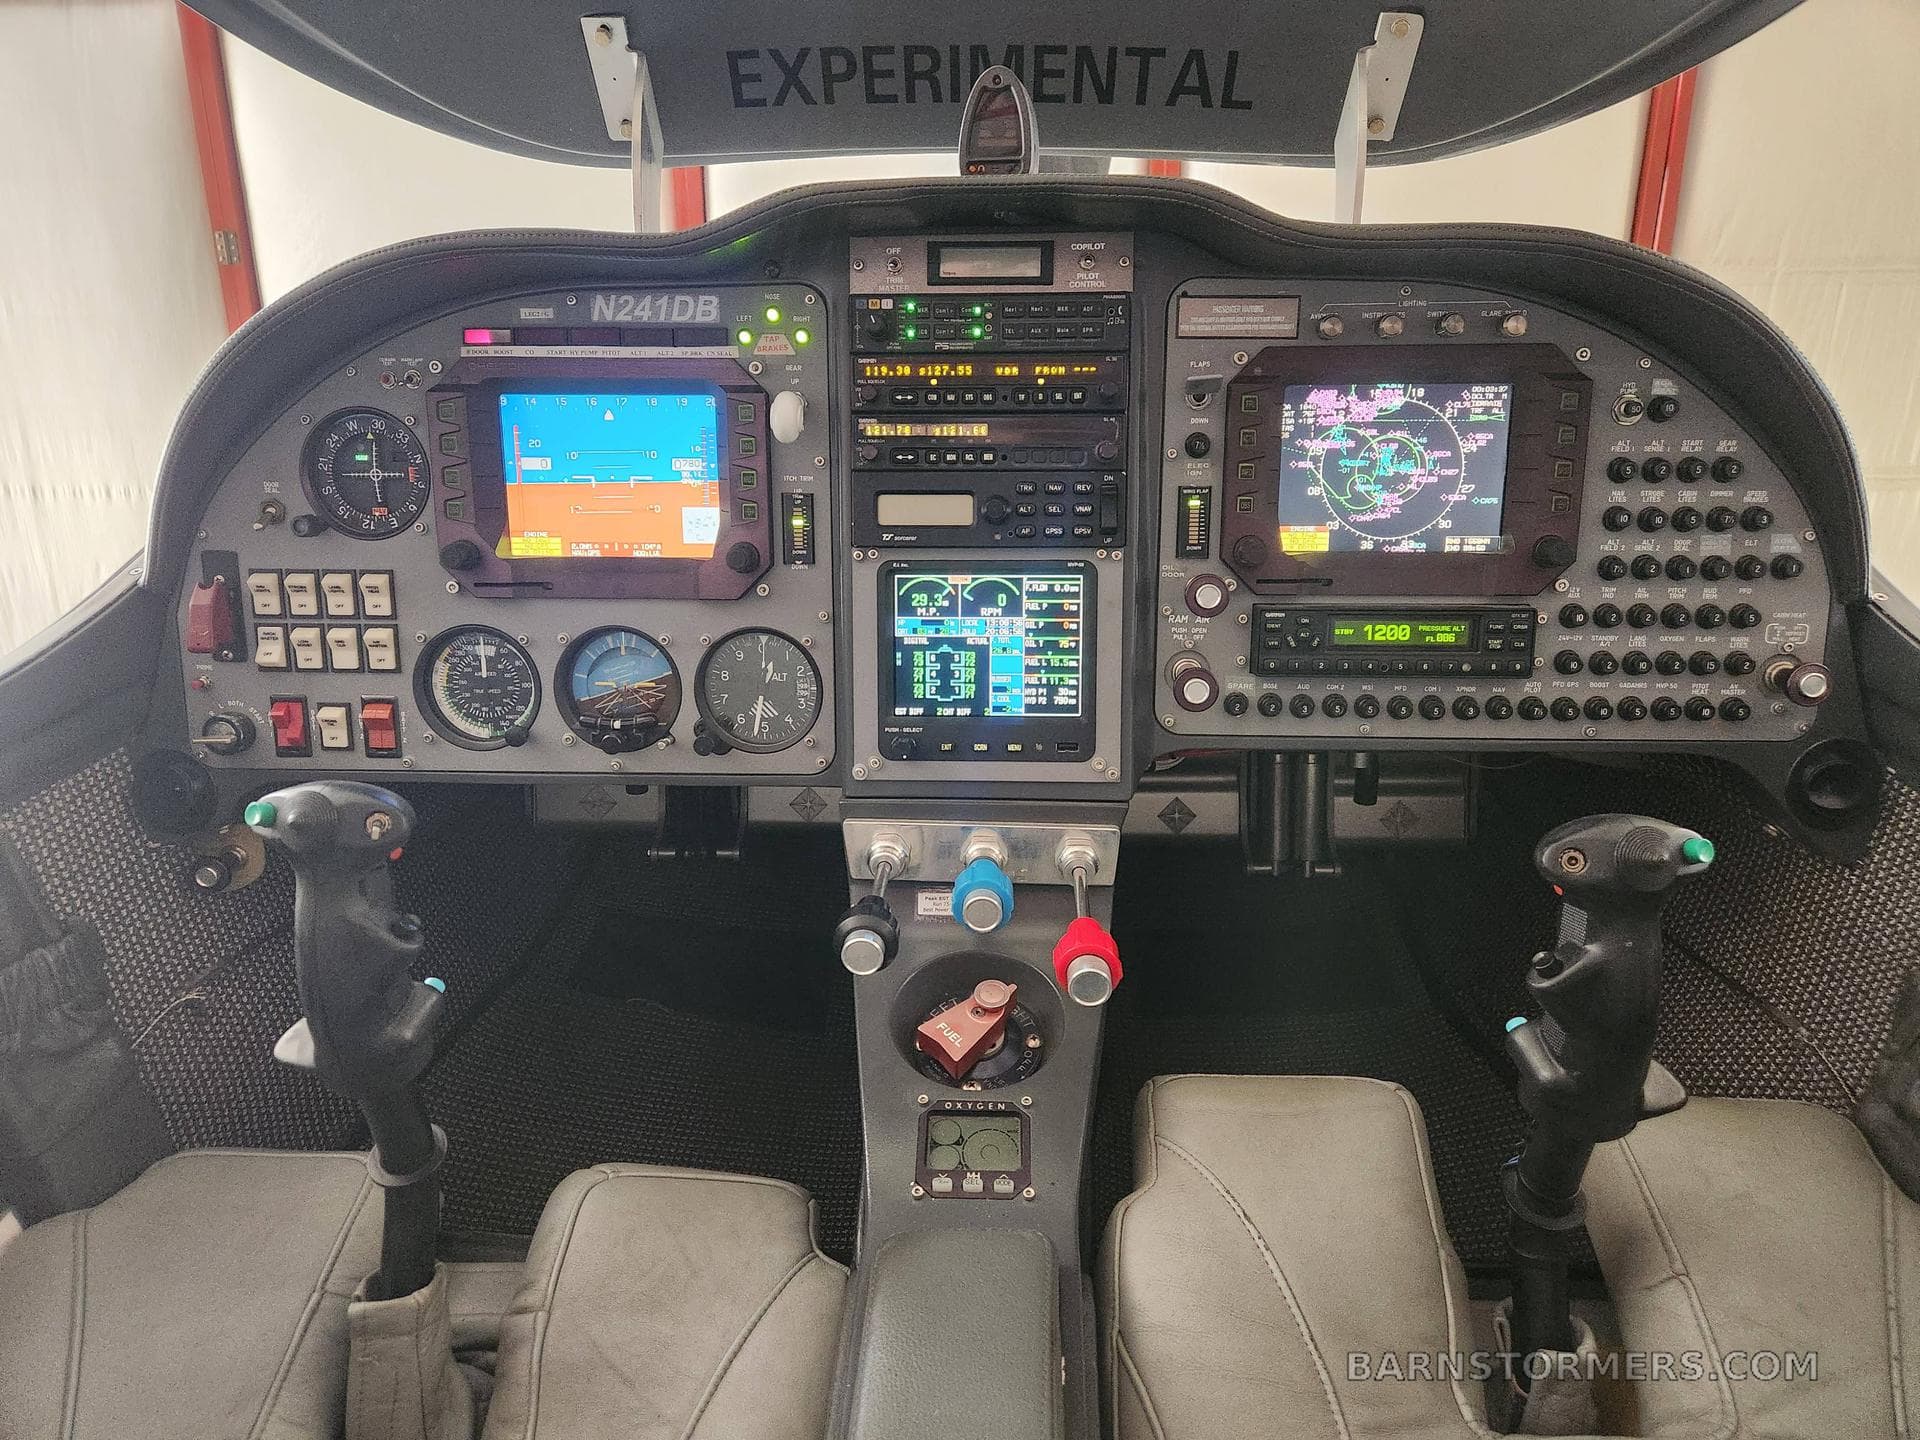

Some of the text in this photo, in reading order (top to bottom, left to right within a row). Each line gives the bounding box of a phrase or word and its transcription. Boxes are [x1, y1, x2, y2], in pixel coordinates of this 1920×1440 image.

[727, 45, 1254, 110] EXPERIMENTAL
[1076, 272, 1100, 280] PILOT
[1069, 281, 1107, 289] CONTROL
[592, 293, 720, 322] N241DB
[757, 344, 789, 352] BRAKES
[1190, 360, 1211, 368] FLAPS
[865, 365, 911, 376] 119.30
[996, 366, 1019, 376] VOR
[1034, 366, 1066, 375] FROM
[1412, 388, 1425, 397] 18
[525, 397, 537, 406] 14
[555, 397, 567, 406] 15
[586, 397, 598, 406] 16
[616, 397, 627, 406] 17
[646, 397, 658, 406] 18
[676, 397, 688, 406] 19
[346, 419, 359, 431] W
[371, 419, 386, 430] 30
[326, 433, 339, 448] 24
[396, 429, 409, 444] 33
[318, 457, 328, 471] 21
[413, 454, 423, 464] N
[322, 485, 333, 495] S
[337, 506, 351, 519] 15
[362, 519, 376, 530] 12
[388, 517, 398, 529] E
[911, 593, 943, 607] 29.3
[917, 608, 940, 616] M.P.
[980, 608, 1003, 616] RPM
[1168, 615, 1188, 624] RAM
[1363, 624, 1411, 641] 1200
[1436, 633, 1456, 643] 006
[735, 650, 744, 661] 9
[721, 670, 729, 681] 8
[772, 673, 788, 682] ALT
[1050, 677, 1069, 685] 11.3
[720, 694, 729, 704] 7
[249, 707, 265, 724] START
[737, 714, 745, 724] 6
[785, 714, 794, 724] 4
[761, 722, 769, 732] 5
[936, 1022, 964, 1048] FUEL
[1017, 1050, 1033, 1072] OFF
[945, 1102, 1006, 1110] OXYGEN
